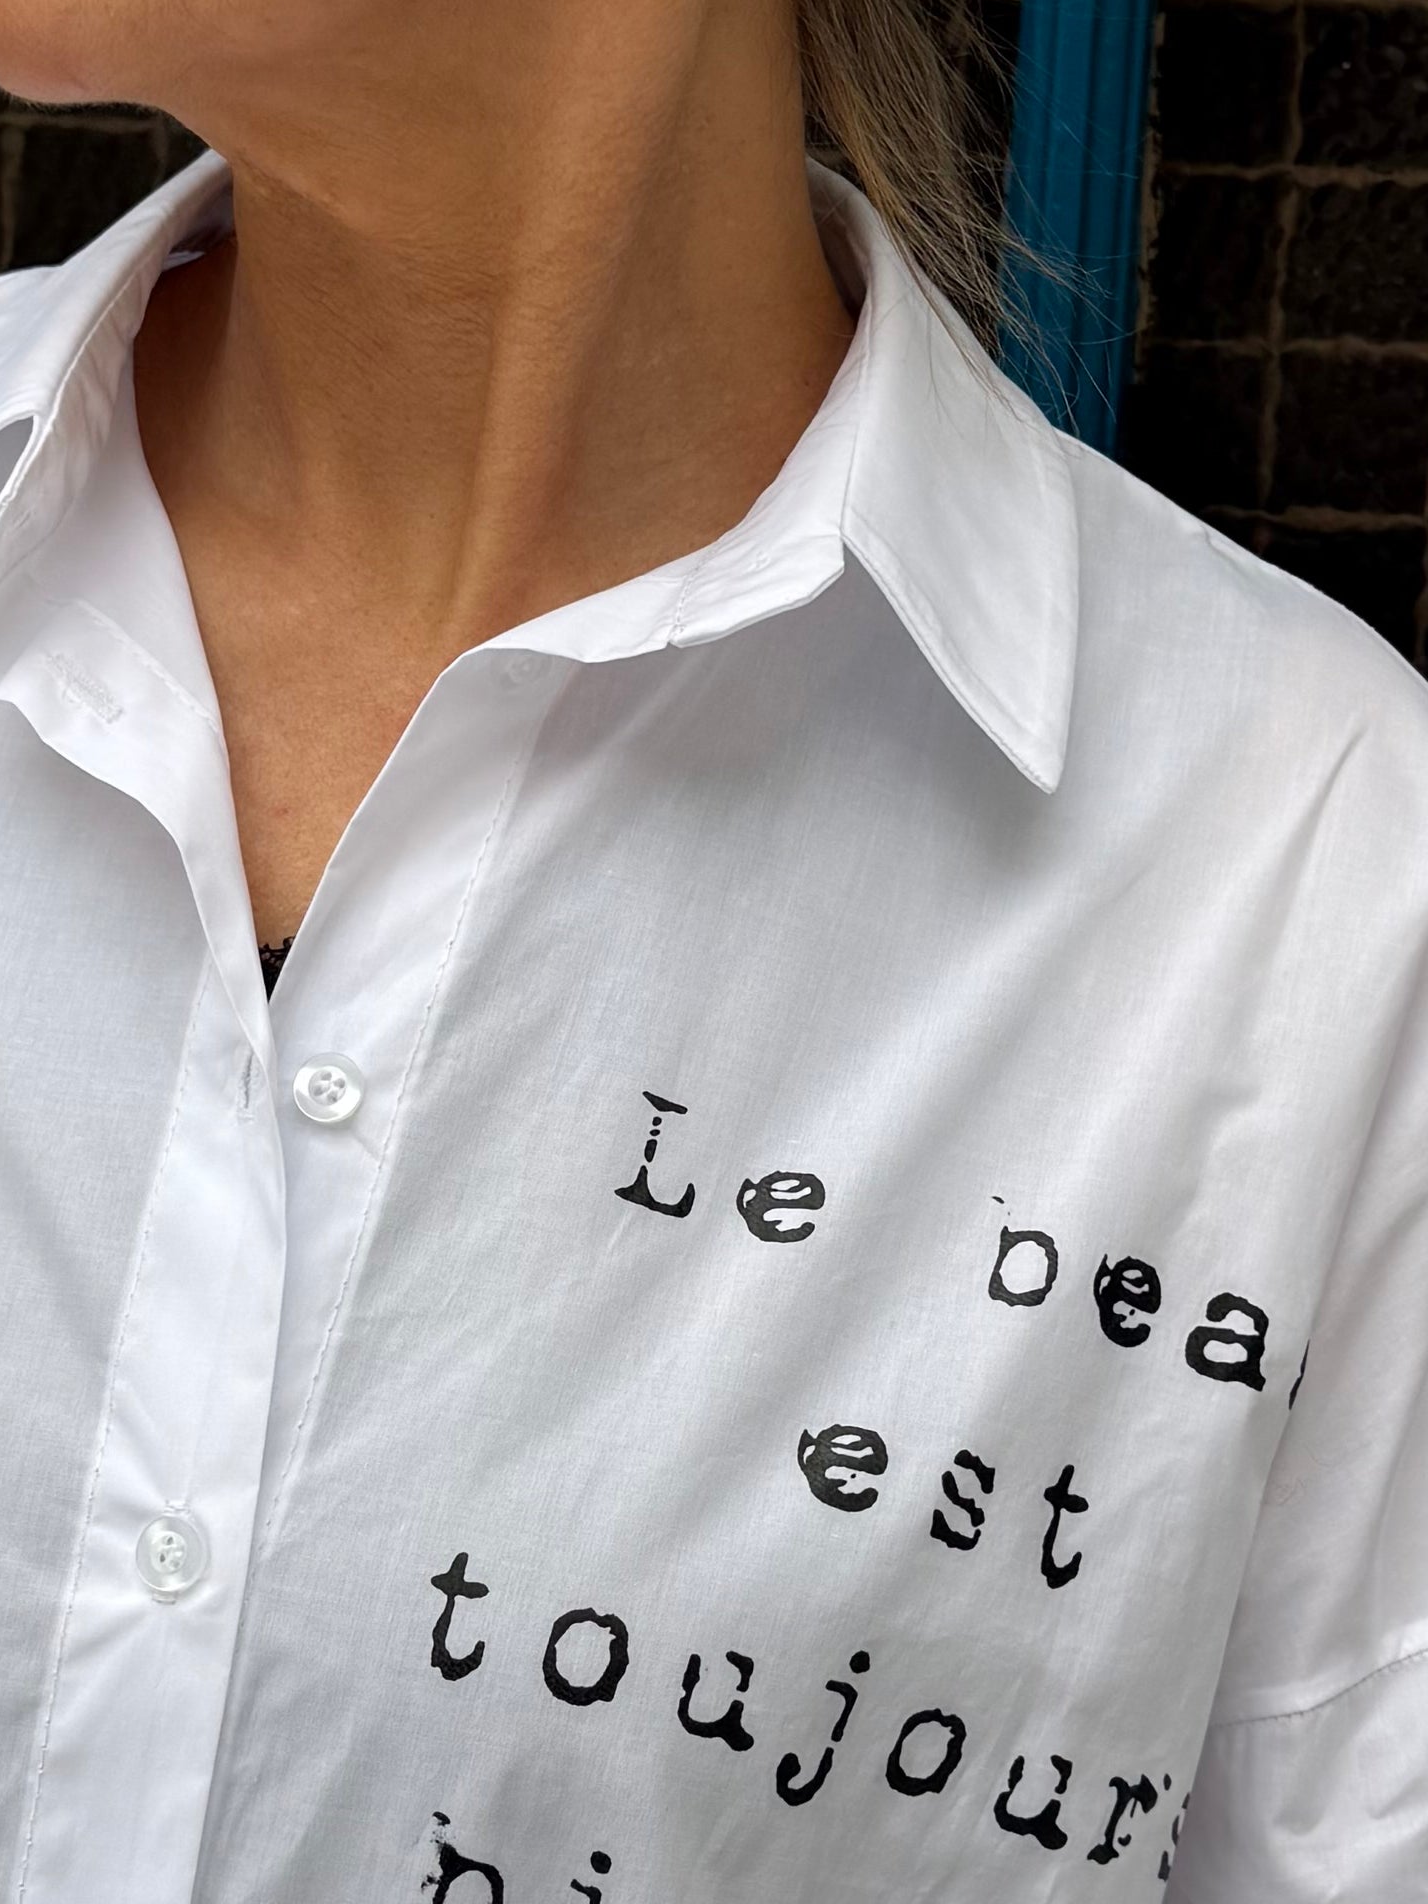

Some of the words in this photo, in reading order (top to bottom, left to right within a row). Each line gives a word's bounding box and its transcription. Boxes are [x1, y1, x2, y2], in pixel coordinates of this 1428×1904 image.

[614, 1090, 826, 1244] Le
[988, 1195, 1311, 1411] bea
[797, 1423, 1089, 1590] est
